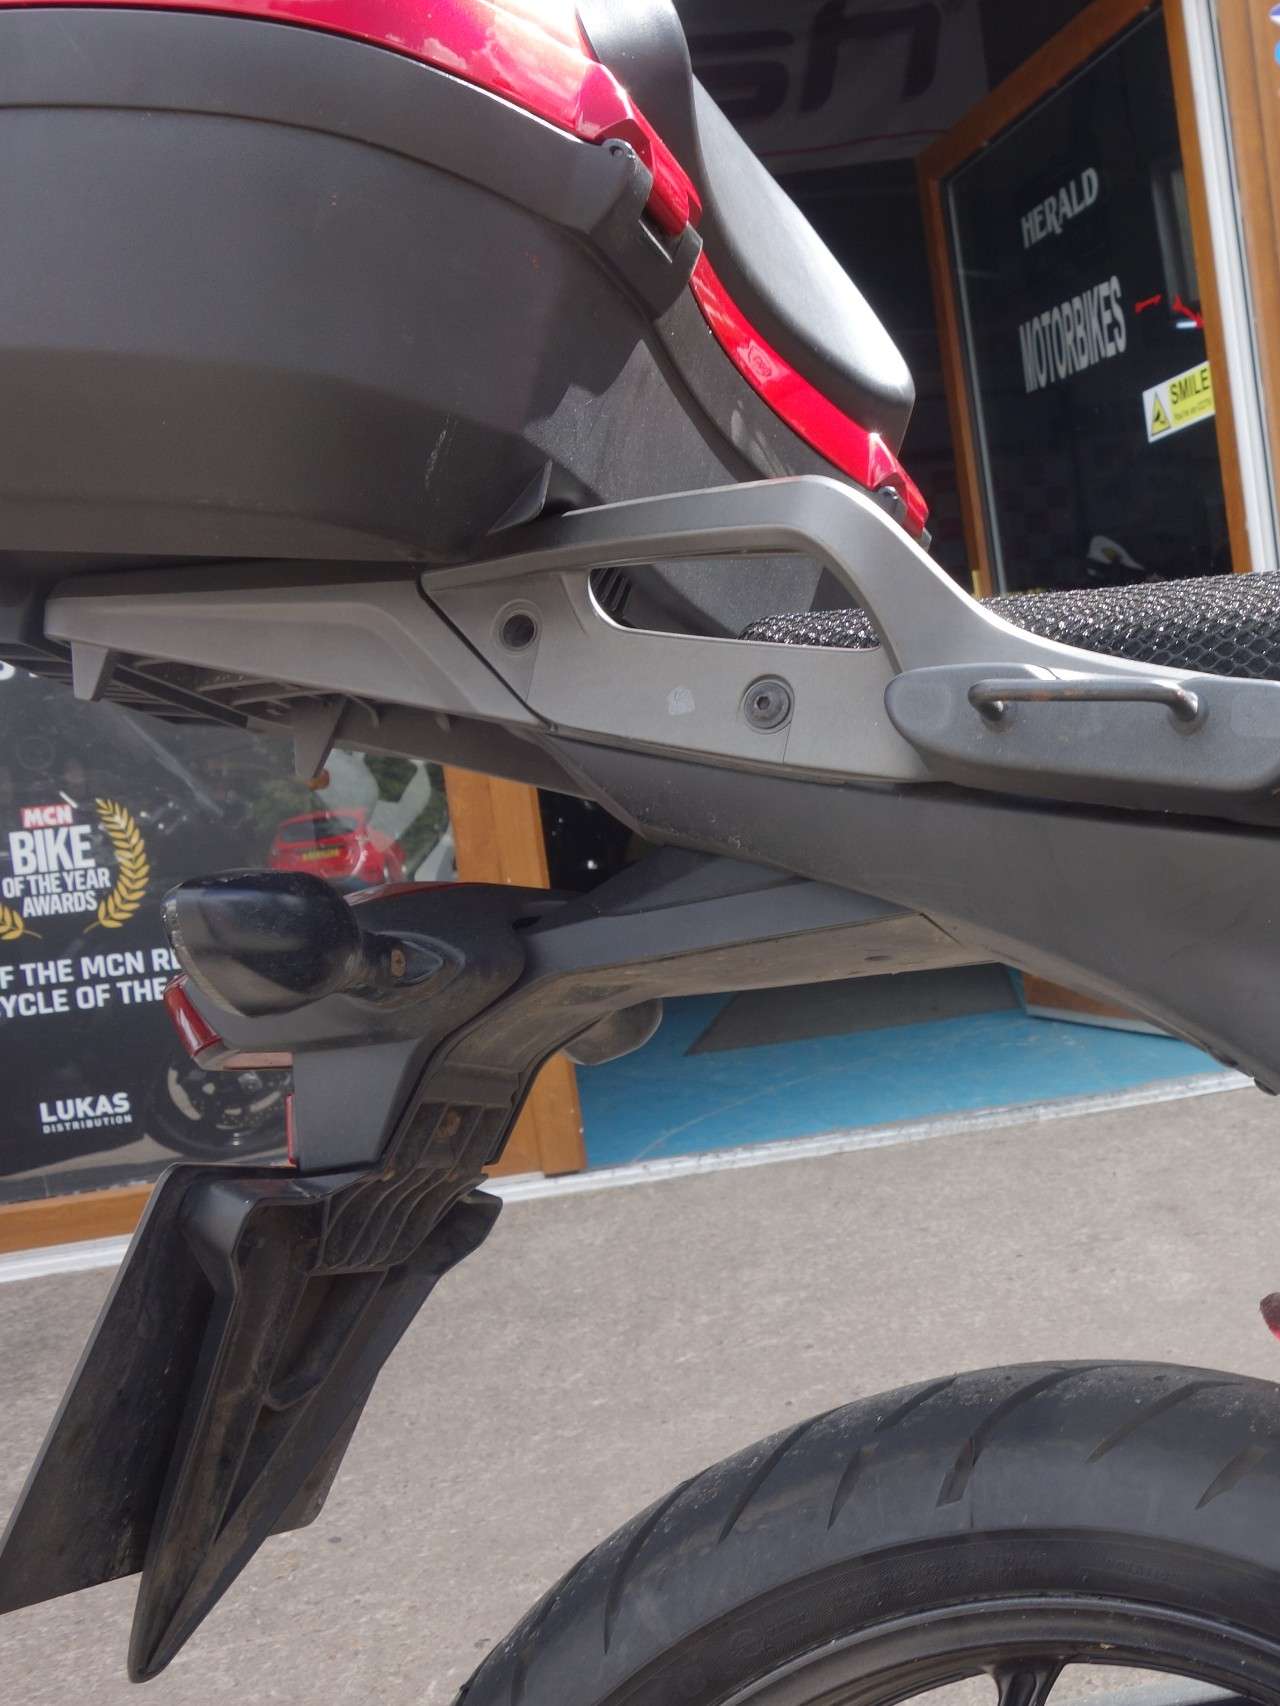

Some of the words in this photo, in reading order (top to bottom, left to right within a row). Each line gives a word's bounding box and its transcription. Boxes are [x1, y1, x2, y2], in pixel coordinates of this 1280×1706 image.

[1020, 167, 1098, 249] HERALD
[1019, 275, 1127, 394] MOTORBIKES
[1170, 368, 1210, 405] SMILE
[23, 805, 73, 827] MCN
[8, 824, 96, 876] BIKE
[2, 877, 25, 898] OF
[26, 872, 62, 896] THE
[62, 867, 111, 892] YEAR
[22, 889, 98, 918] AWARDS
[19, 958, 75, 987] THE
[81, 952, 145, 981] MCN
[0, 988, 70, 1018] YCLE
[76, 983, 111, 1009] OF
[120, 976, 167, 1005] THE
[39, 1092, 130, 1123] LUKAS
[42, 1113, 133, 1134] DISTRIBUTION
